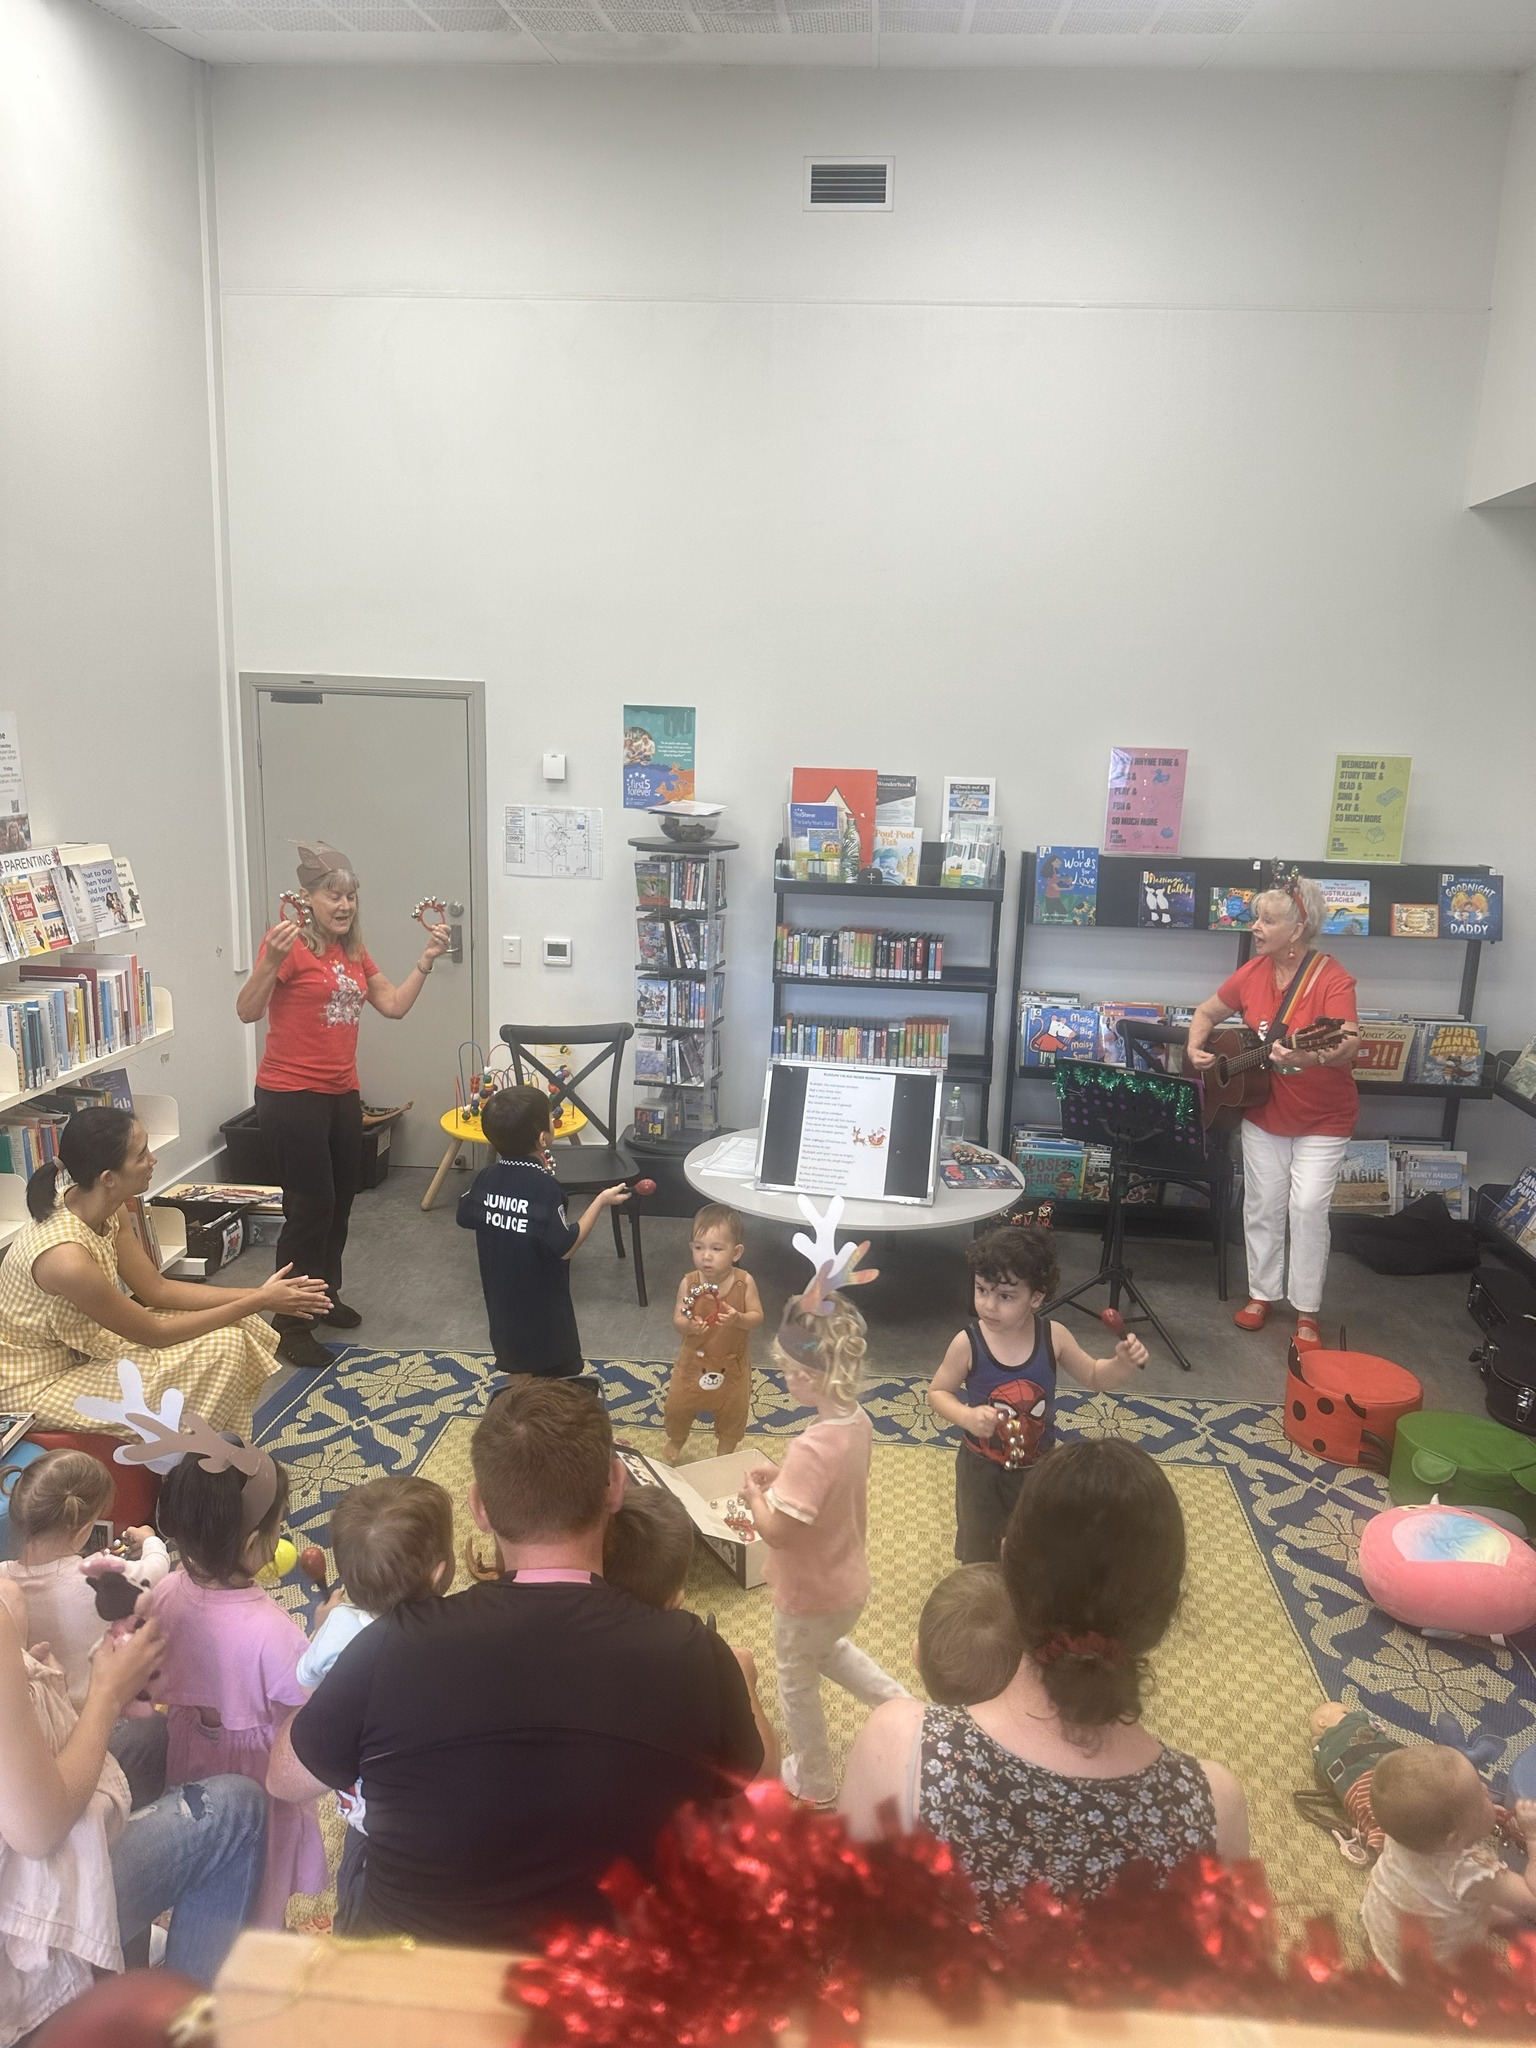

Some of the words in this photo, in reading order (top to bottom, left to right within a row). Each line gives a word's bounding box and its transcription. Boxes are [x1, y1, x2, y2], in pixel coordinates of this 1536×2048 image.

[1134, 757, 1157, 766] RHYME
[1158, 758, 1173, 767] TIME
[1341, 760, 1378, 769] WEDNESDAY
[1380, 761, 1386, 769] &
[1340, 771, 1360, 780] STORY
[1361, 772, 1377, 780] TIME
[1378, 772, 1384, 780] &
[1339, 781, 1355, 790] READ
[1357, 782, 1362, 790] &
[1114, 787, 1130, 795] PLAY
[1132, 787, 1137, 796] &
[1337, 792, 1352, 801] SING
[1354, 793, 1360, 801] &
[1113, 802, 1125, 810] FUN
[1336, 803, 1352, 811] PLAY
[1111, 817, 1120, 825] SO
[1121, 817, 1139, 825] MUCH
[1140, 818, 1158, 826] MORE
[1335, 814, 1344, 822] SO
[1345, 814, 1363, 823] MUCH
[1363, 814, 1382, 823] MORE
[881, 837, 897, 846] Fish
[1076, 849, 1085, 859] 11
[4, 854, 52, 872] PARENTING
[1064, 857, 1097, 869] Words
[102, 868, 112, 876] Do
[1081, 868, 1090, 876] for
[97, 877, 112, 885] Your
[1071, 871, 1097, 887] Love
[99, 885, 112, 893] Isn't
[1167, 884, 1194, 899] Lullaby
[1445, 883, 1496, 898] GOODNIGHT
[1326, 896, 1354, 904] BEACHES
[1450, 923, 1488, 935] DADDY
[1070, 1013, 1095, 1027] Maisy
[1386, 1031, 1406, 1040] Zoo
[1437, 1026, 1477, 1039] SUPER
[1071, 1040, 1094, 1051] Maisy
[1431, 1036, 1480, 1049] MANNY
[1428, 1046, 1464, 1056] STANDS
[1433, 1172, 1459, 1180] HARBOUR
[484, 1193, 529, 1214] JUNIOR
[486, 1211, 529, 1233] POLICE
